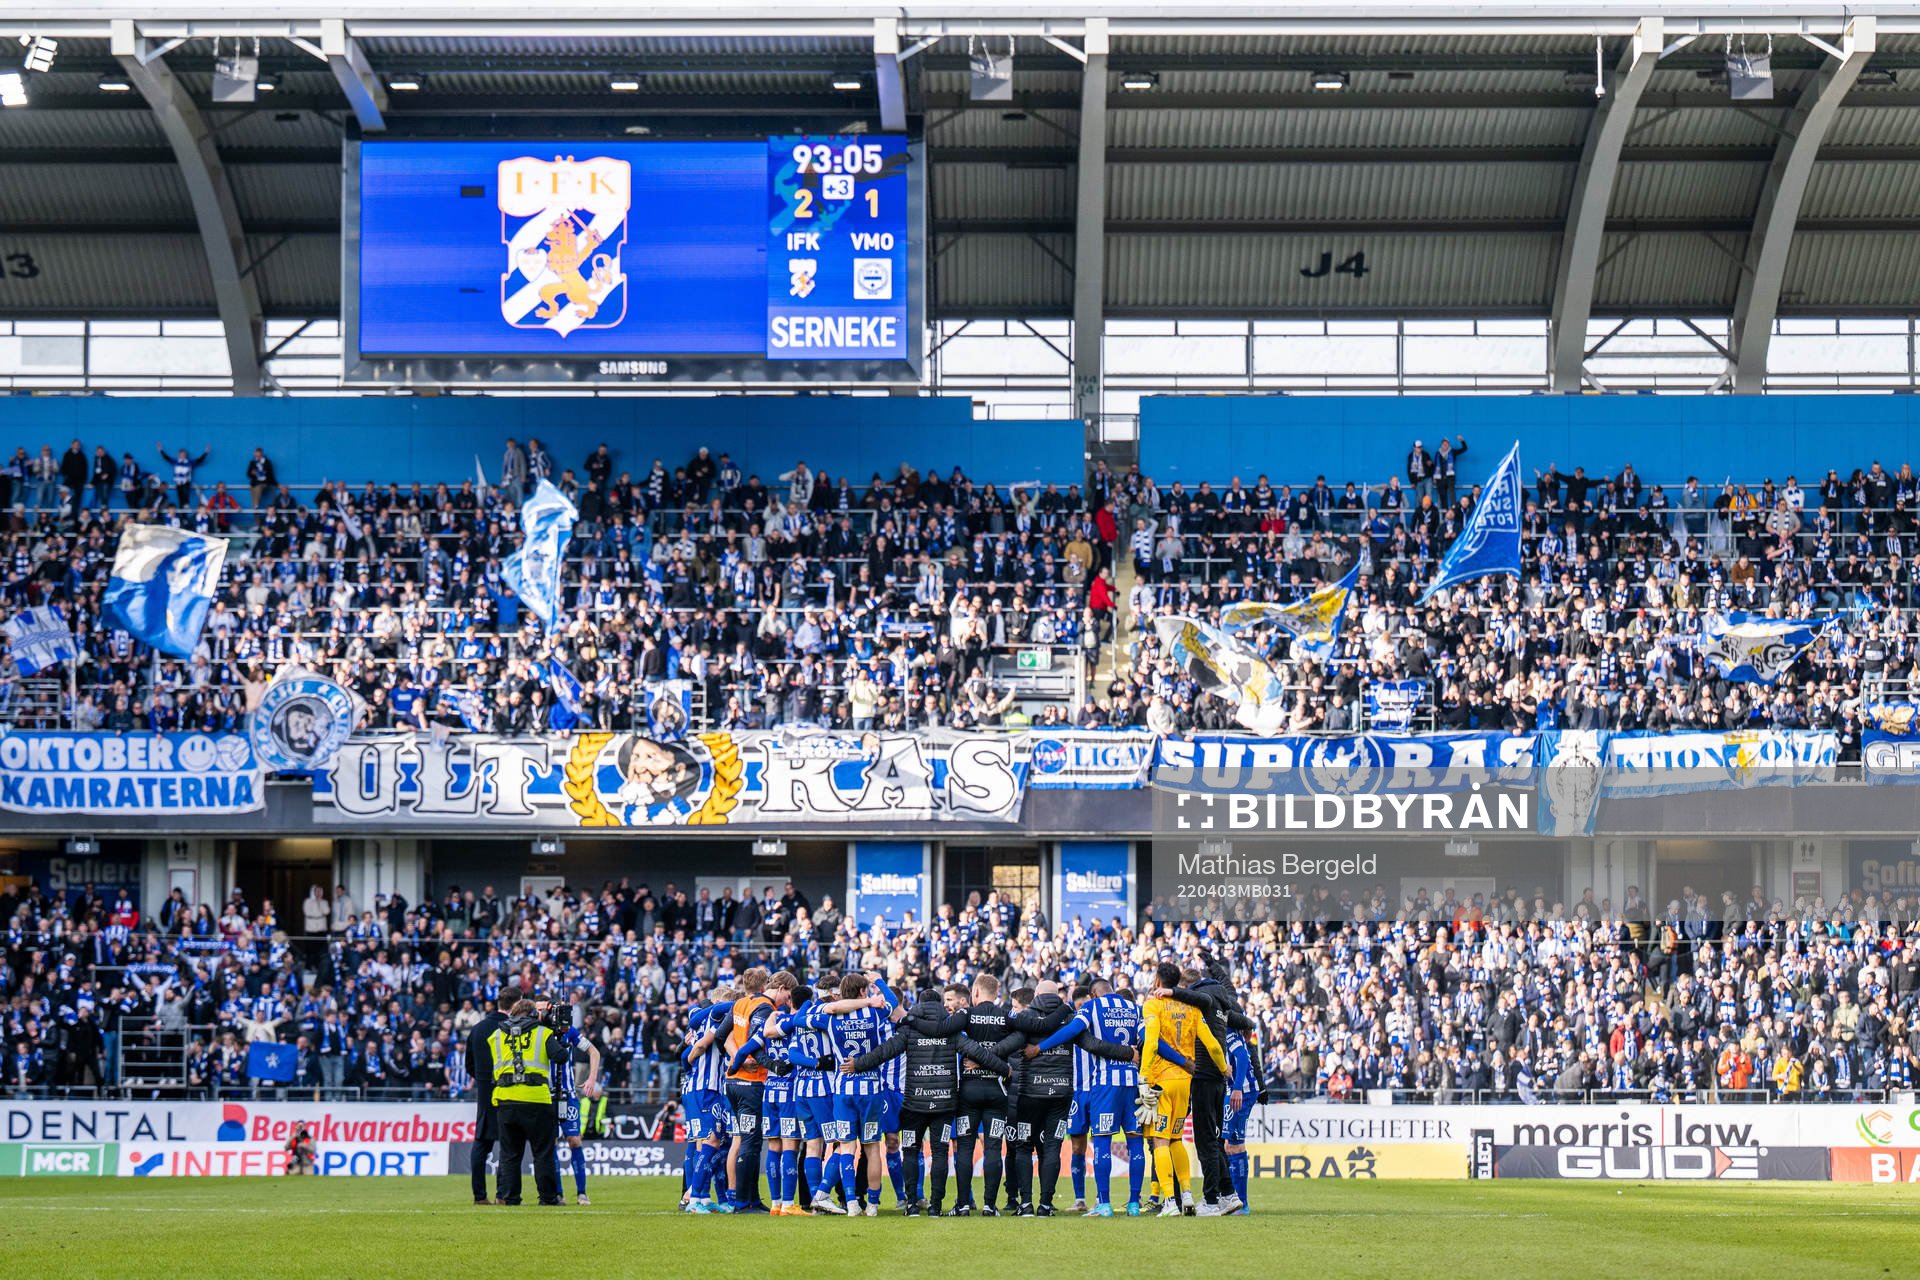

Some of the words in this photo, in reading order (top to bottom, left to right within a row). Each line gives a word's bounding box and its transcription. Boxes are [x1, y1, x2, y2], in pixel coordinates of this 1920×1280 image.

[793, 144, 883, 174] 93:05
[826, 179, 850, 196] +3
[794, 188, 813, 218] 2
[865, 188, 879, 218] 1
[787, 232, 820, 251] IFK
[850, 232, 894, 251] VMO
[1300, 251, 1369, 278] J4
[771, 316, 897, 348] SERNEKE
[599, 360, 668, 375] SAMSUNG
[1, 737, 173, 770] OKTOBER
[2, 775, 254, 807] KAMRATERNA
[970, 1015, 1006, 1025] SERNEKE
[917, 1038, 947, 1046] SERNEKE
[8, 1111, 187, 1141] DENTAL
[1245, 1119, 1452, 1139] ENFASTIGHETER
[1513, 1112, 1653, 1147] morris
[32, 1151, 90, 1172] MCR
[556, 1143, 664, 1166] öeborgs
[1558, 1147, 1758, 1179] GUIDE
